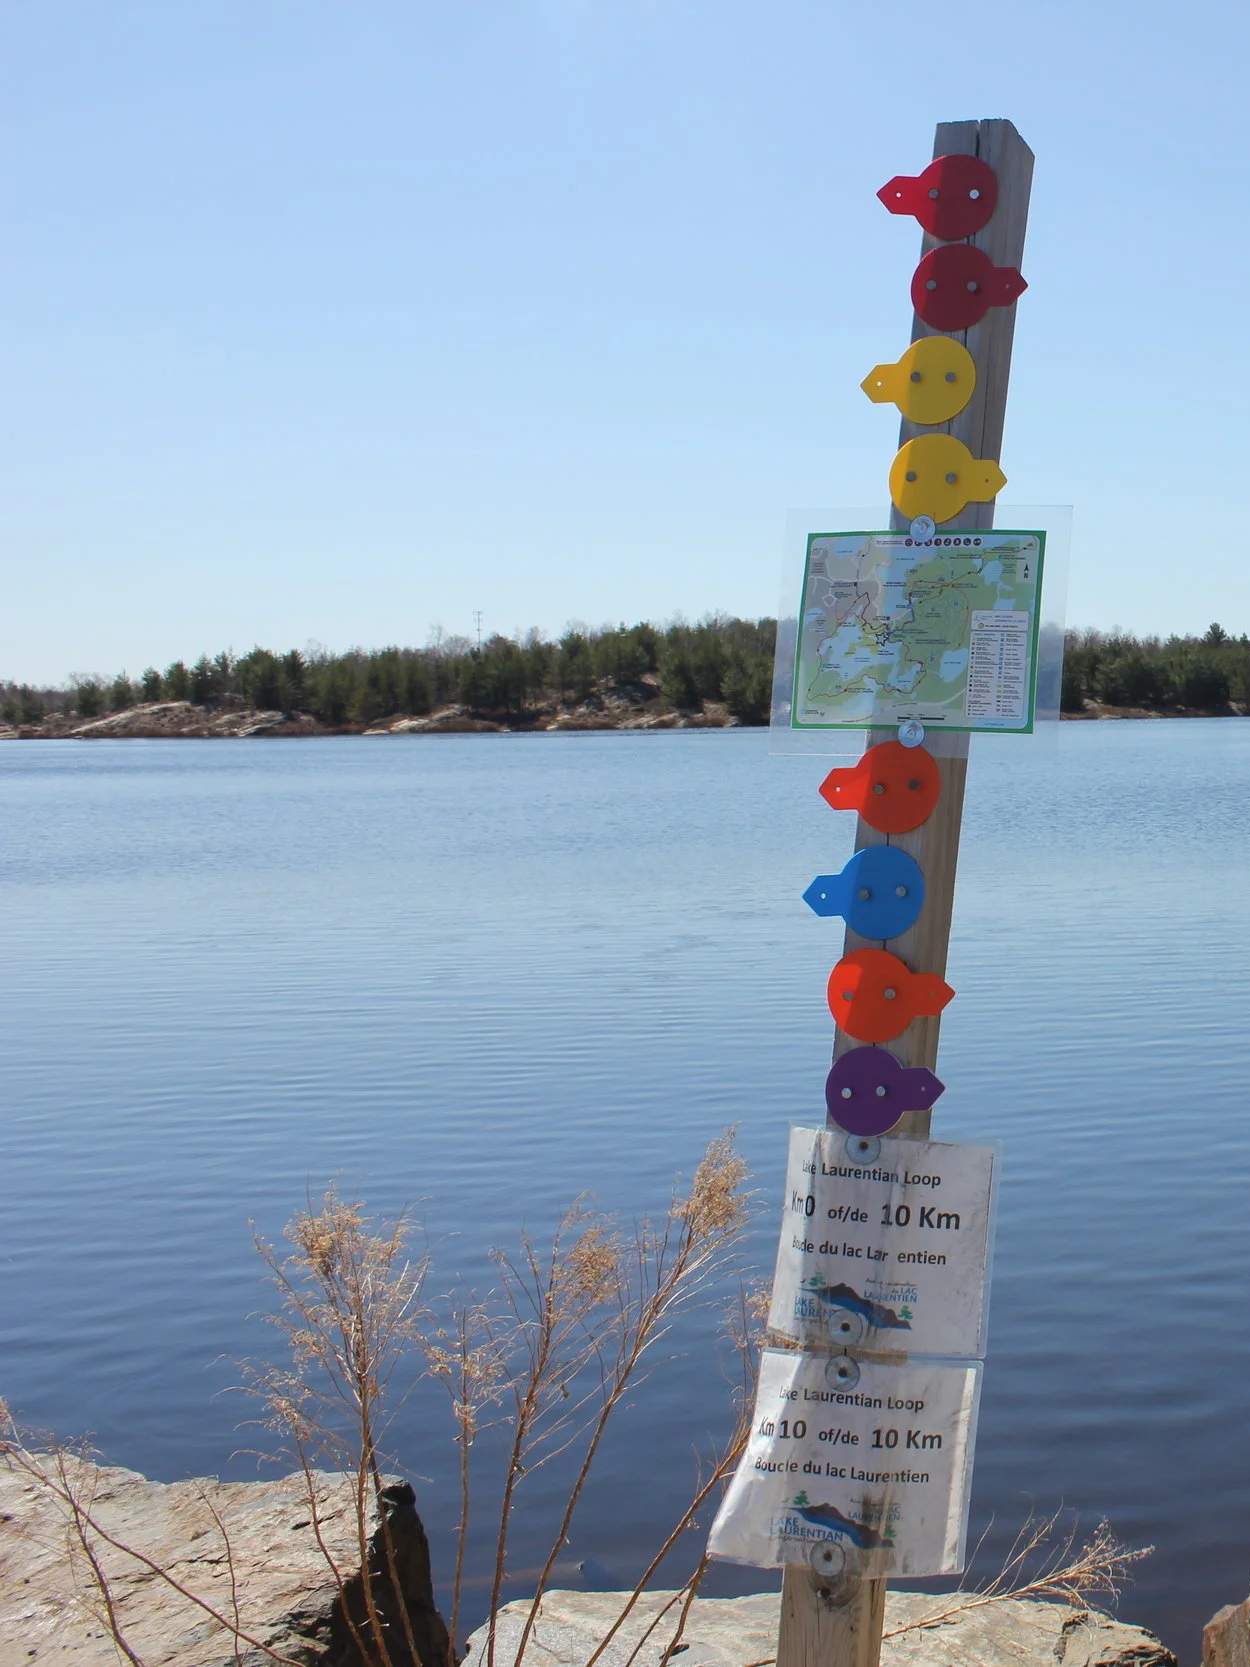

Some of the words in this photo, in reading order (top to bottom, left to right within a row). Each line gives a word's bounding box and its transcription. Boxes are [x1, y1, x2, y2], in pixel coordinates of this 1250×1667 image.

[821, 1163, 899, 1183] Laurentian
[904, 1171, 941, 1189] Loop
[827, 1205, 869, 1223] of/de
[881, 1203, 911, 1228] 10
[919, 1206, 960, 1230] Km
[819, 1240, 838, 1256] du
[842, 1242, 863, 1259] lac
[804, 1388, 882, 1409] Laurentian
[887, 1396, 924, 1413] Loop
[759, 1415, 775, 1437] Km
[779, 1420, 807, 1439] 10
[818, 1428, 859, 1446] of/de
[871, 1428, 899, 1449] 10
[906, 1429, 942, 1449] Km
[755, 1456, 798, 1473] Boucle
[803, 1461, 821, 1475] du
[826, 1462, 846, 1478] lac
[850, 1466, 929, 1484] Laurentien
[770, 1516, 799, 1527] LAKE
